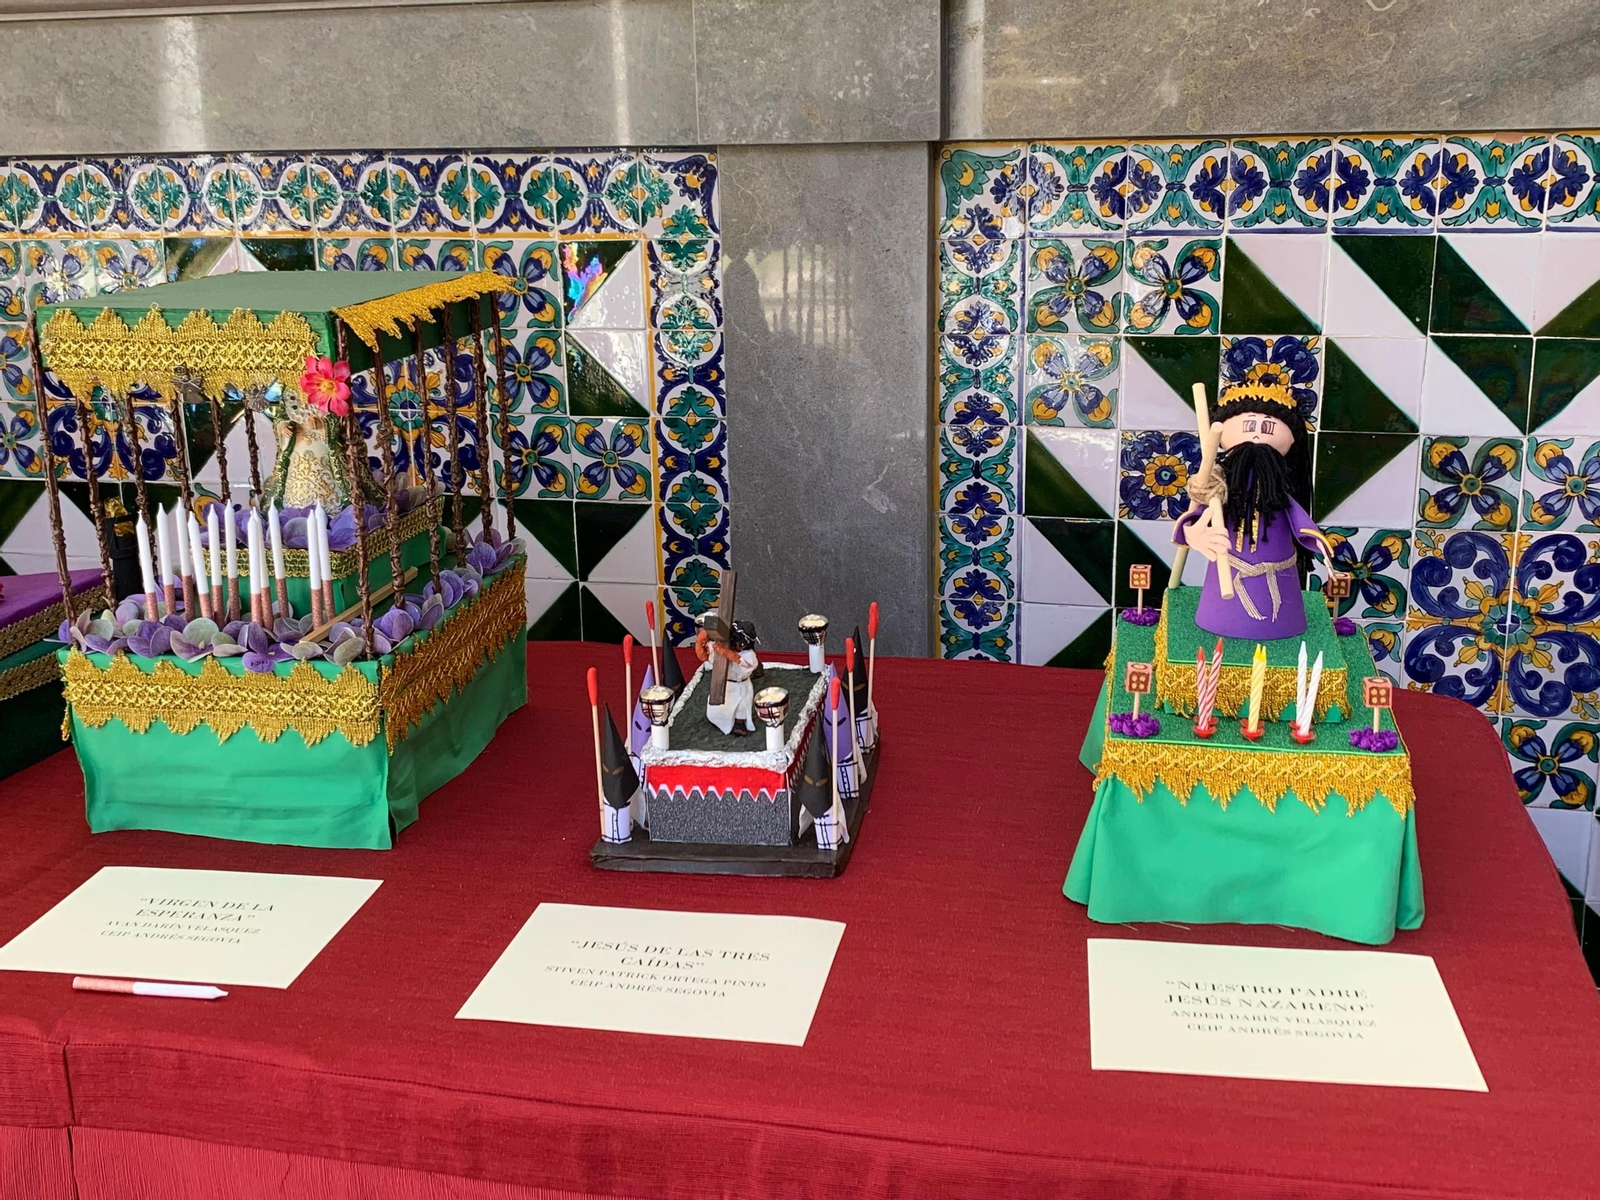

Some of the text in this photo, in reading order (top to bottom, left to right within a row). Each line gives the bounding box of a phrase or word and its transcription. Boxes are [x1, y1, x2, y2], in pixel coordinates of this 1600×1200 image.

[222, 902, 249, 910] DE
[142, 922, 181, 930] DARÍN
[187, 925, 261, 934] VELASQUEZ
[644, 945, 672, 954] DE
[677, 947, 714, 958] LAS
[720, 950, 771, 961] TRES
[545, 966, 766, 988] STIVEN PATRICK ORTEGA PINTO
[571, 979, 726, 997] CEIP ANDRÉS SEGOVIA
[1290, 987, 1368, 999] PADRE
[1165, 994, 1231, 1006] JESÚS
[1171, 1010, 1377, 1028] ANDER DARÍN VELASQUEZ
[1187, 1023, 1364, 1039] CEIP ANDRÉS SEGOVIA
